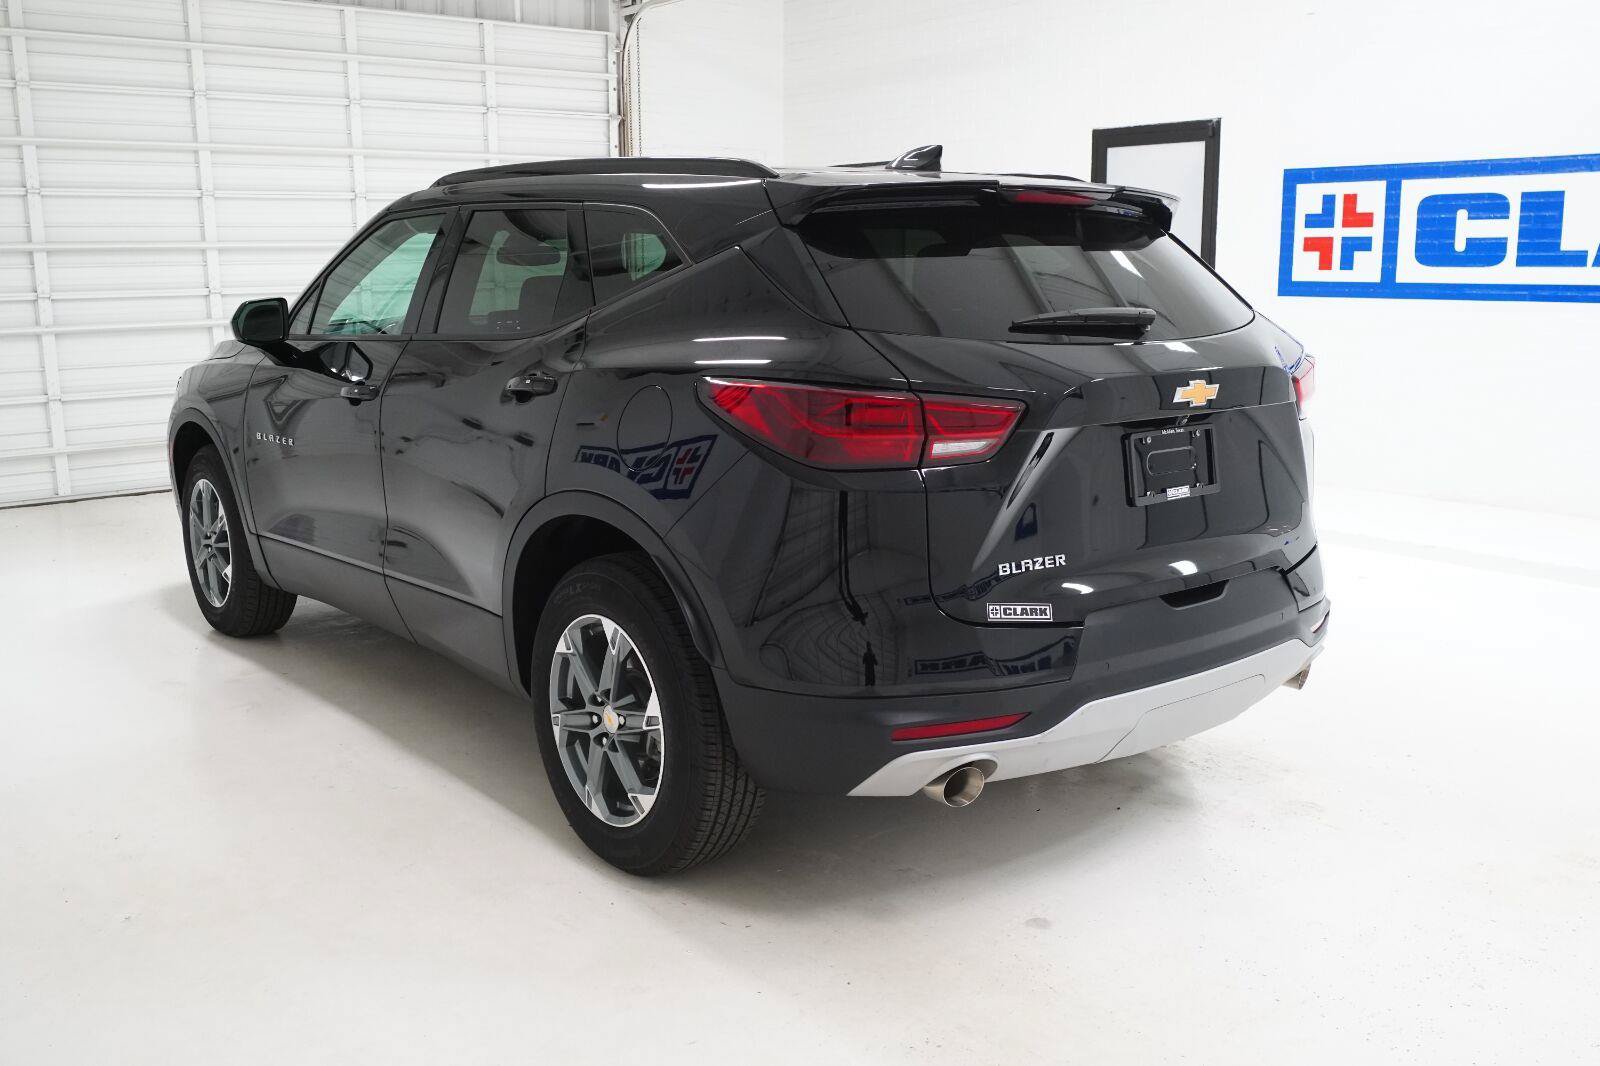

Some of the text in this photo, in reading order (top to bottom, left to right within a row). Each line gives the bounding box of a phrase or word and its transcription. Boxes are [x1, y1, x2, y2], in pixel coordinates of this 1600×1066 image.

[1414, 190, 1600, 268] CL
[256, 431, 294, 447] BLAZER
[998, 554, 1066, 576] BLAZER
[1002, 607, 1049, 617] CLARK
